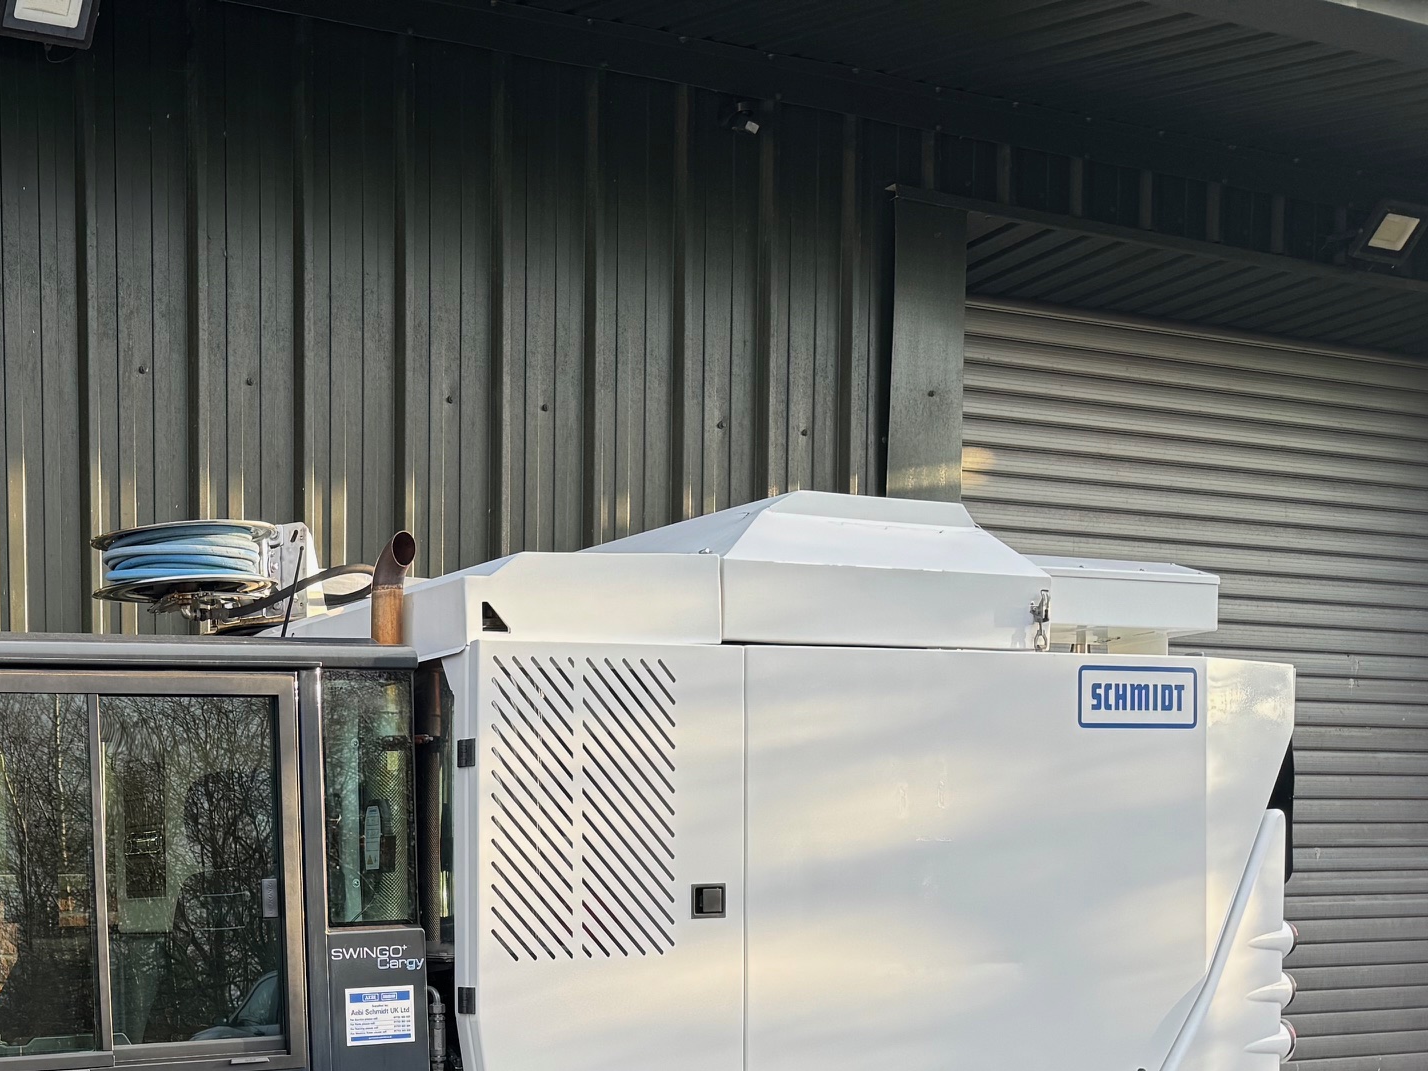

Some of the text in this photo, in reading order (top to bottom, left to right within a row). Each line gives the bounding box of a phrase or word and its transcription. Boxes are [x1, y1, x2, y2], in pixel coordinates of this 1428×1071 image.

[1091, 683, 1185, 711] SCHMIDT
[377, 957, 424, 971] Cargy
[365, 1008, 389, 1016] Schmidt
